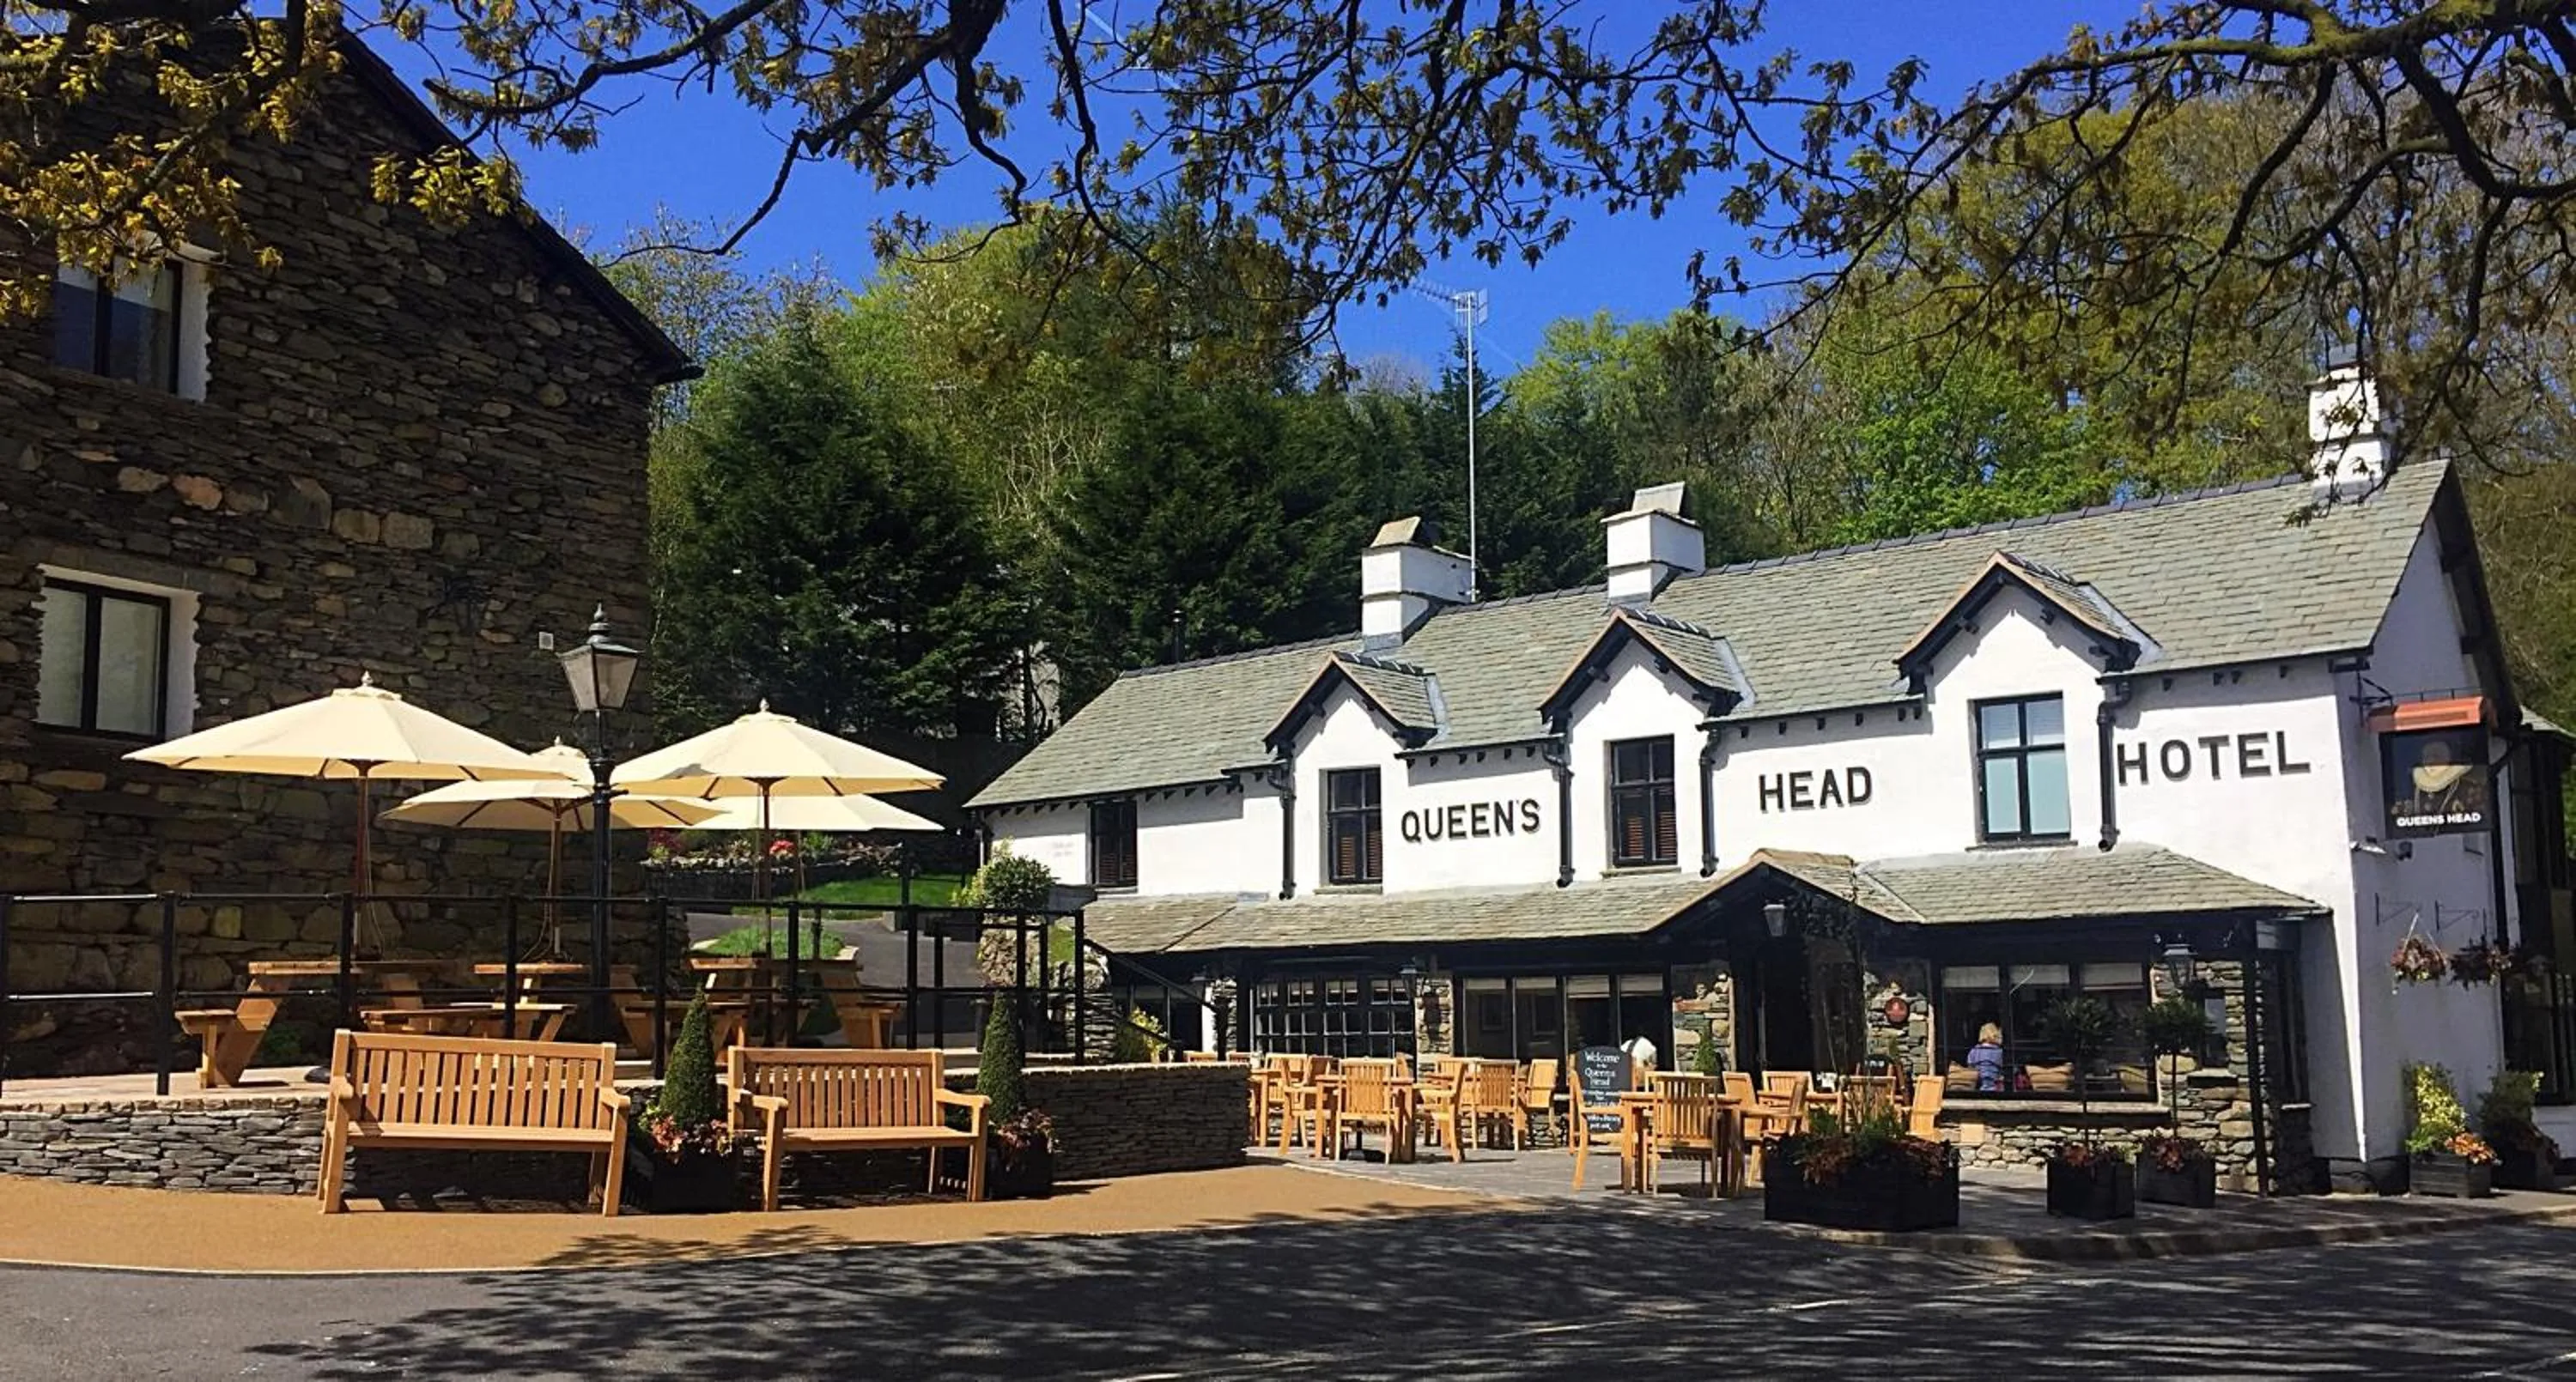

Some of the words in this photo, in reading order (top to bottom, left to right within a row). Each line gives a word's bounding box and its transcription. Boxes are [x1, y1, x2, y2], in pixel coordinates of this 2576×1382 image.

[1401, 798, 1540, 844] QUEEN'S
[1759, 767, 1873, 814] HEAD
[2117, 730, 2312, 786] HOTEL
[2397, 815, 2445, 827] QUEENS
[2447, 812, 2481, 823] HEAD
[1584, 1051, 1619, 1064] Welcome
